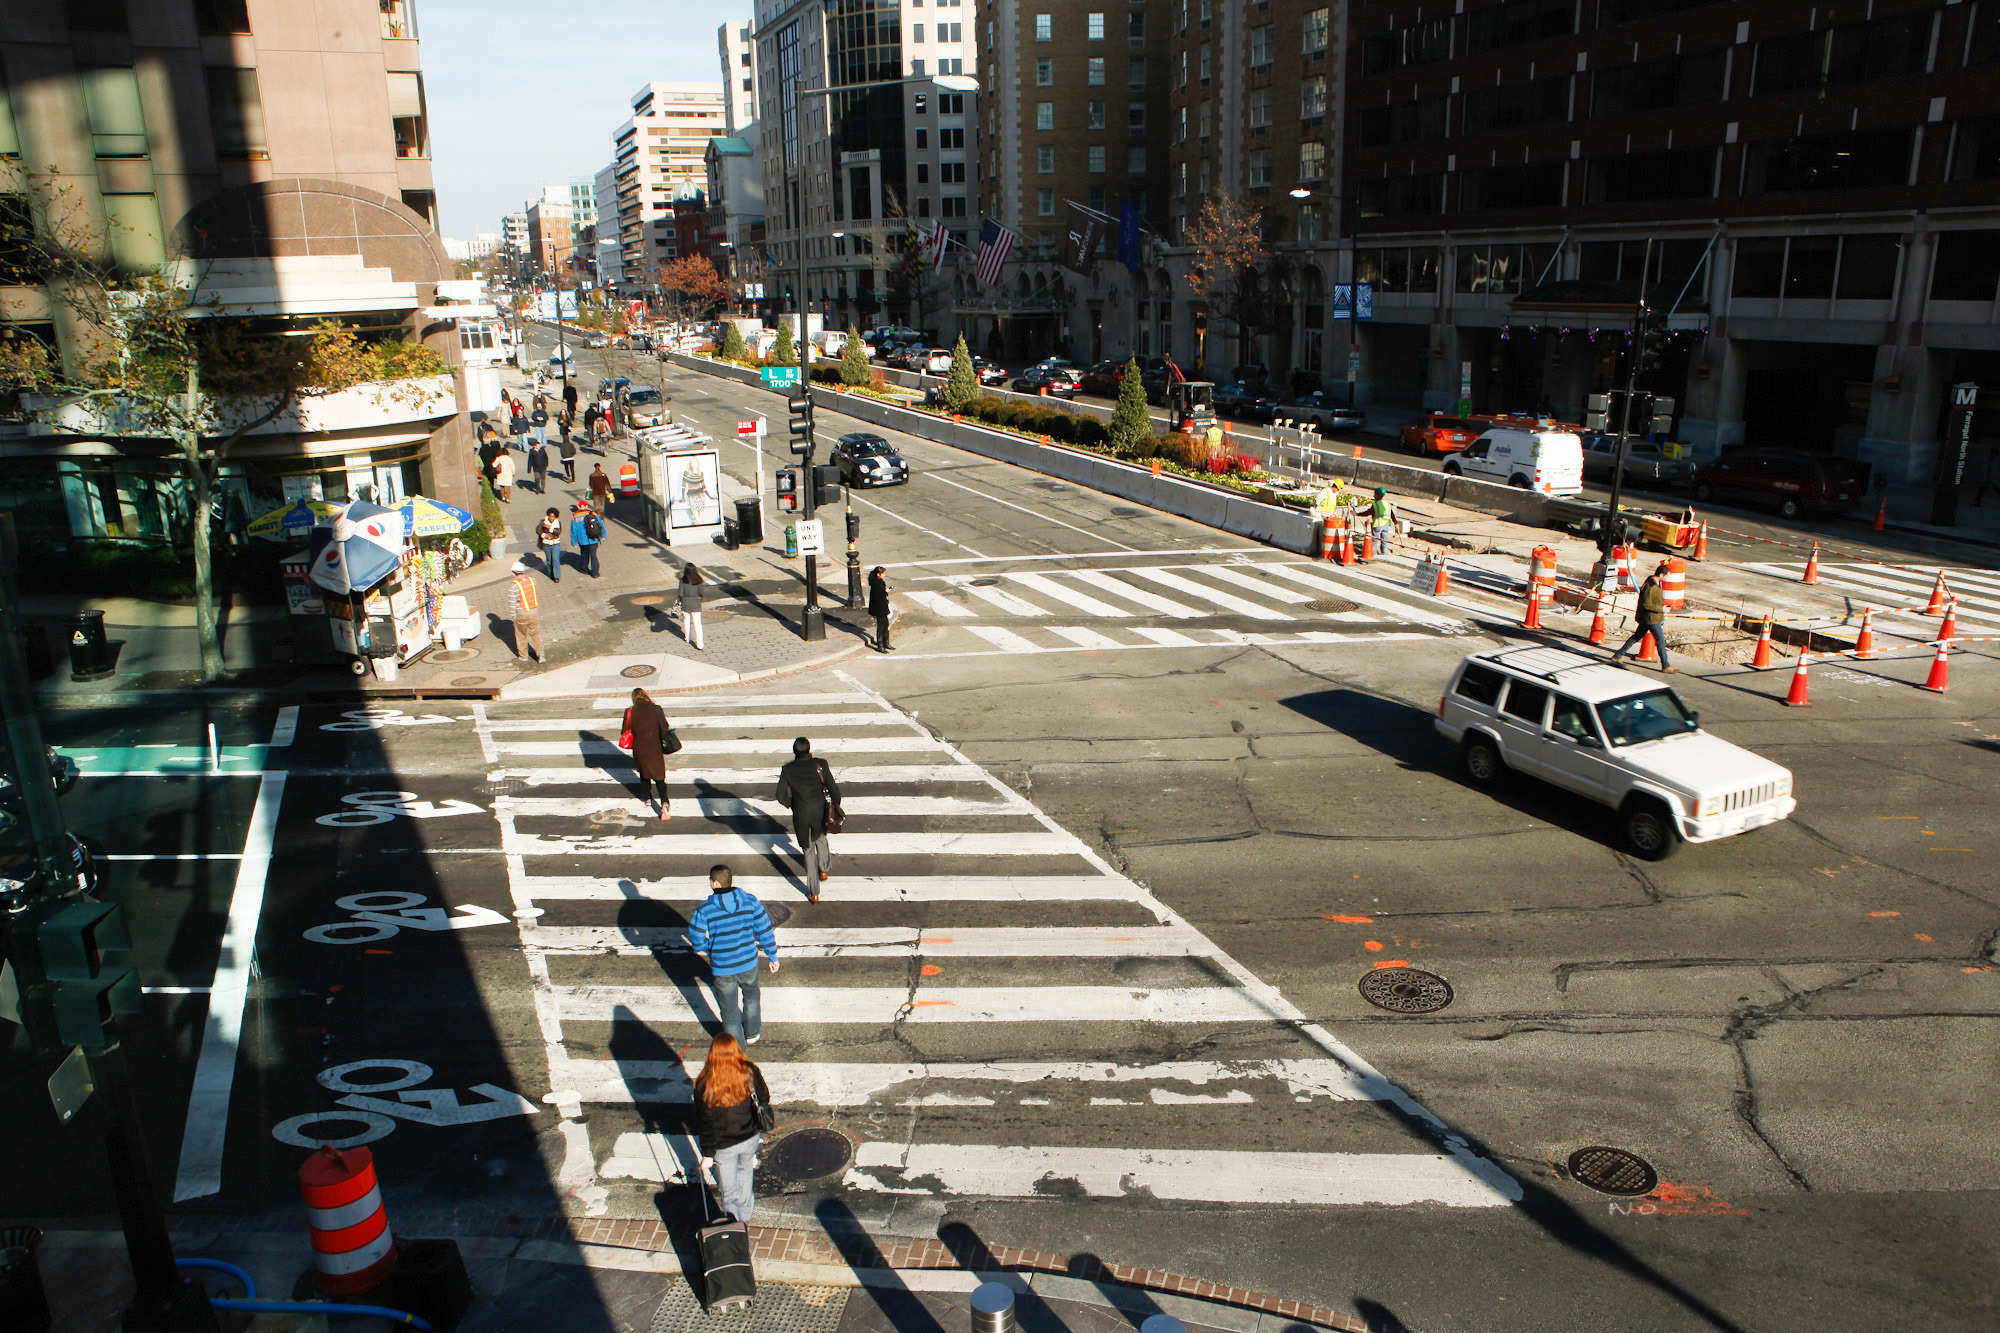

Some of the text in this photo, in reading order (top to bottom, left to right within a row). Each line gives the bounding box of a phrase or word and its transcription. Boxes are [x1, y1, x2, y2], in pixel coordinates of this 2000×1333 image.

[769, 368, 778, 379] L
[1956, 388, 1977, 405] M
[1494, 446, 1512, 454] ABM
[1954, 410, 1974, 485] Farragut North Station
[783, 495, 795, 508] 15
[249, 520, 279, 533] SABRETT
[417, 523, 458, 533] SABRETT
[801, 524, 817, 532] ONE
[1415, 571, 1435, 581] CLOSED
[1608, 1202, 1657, 1216] NO
